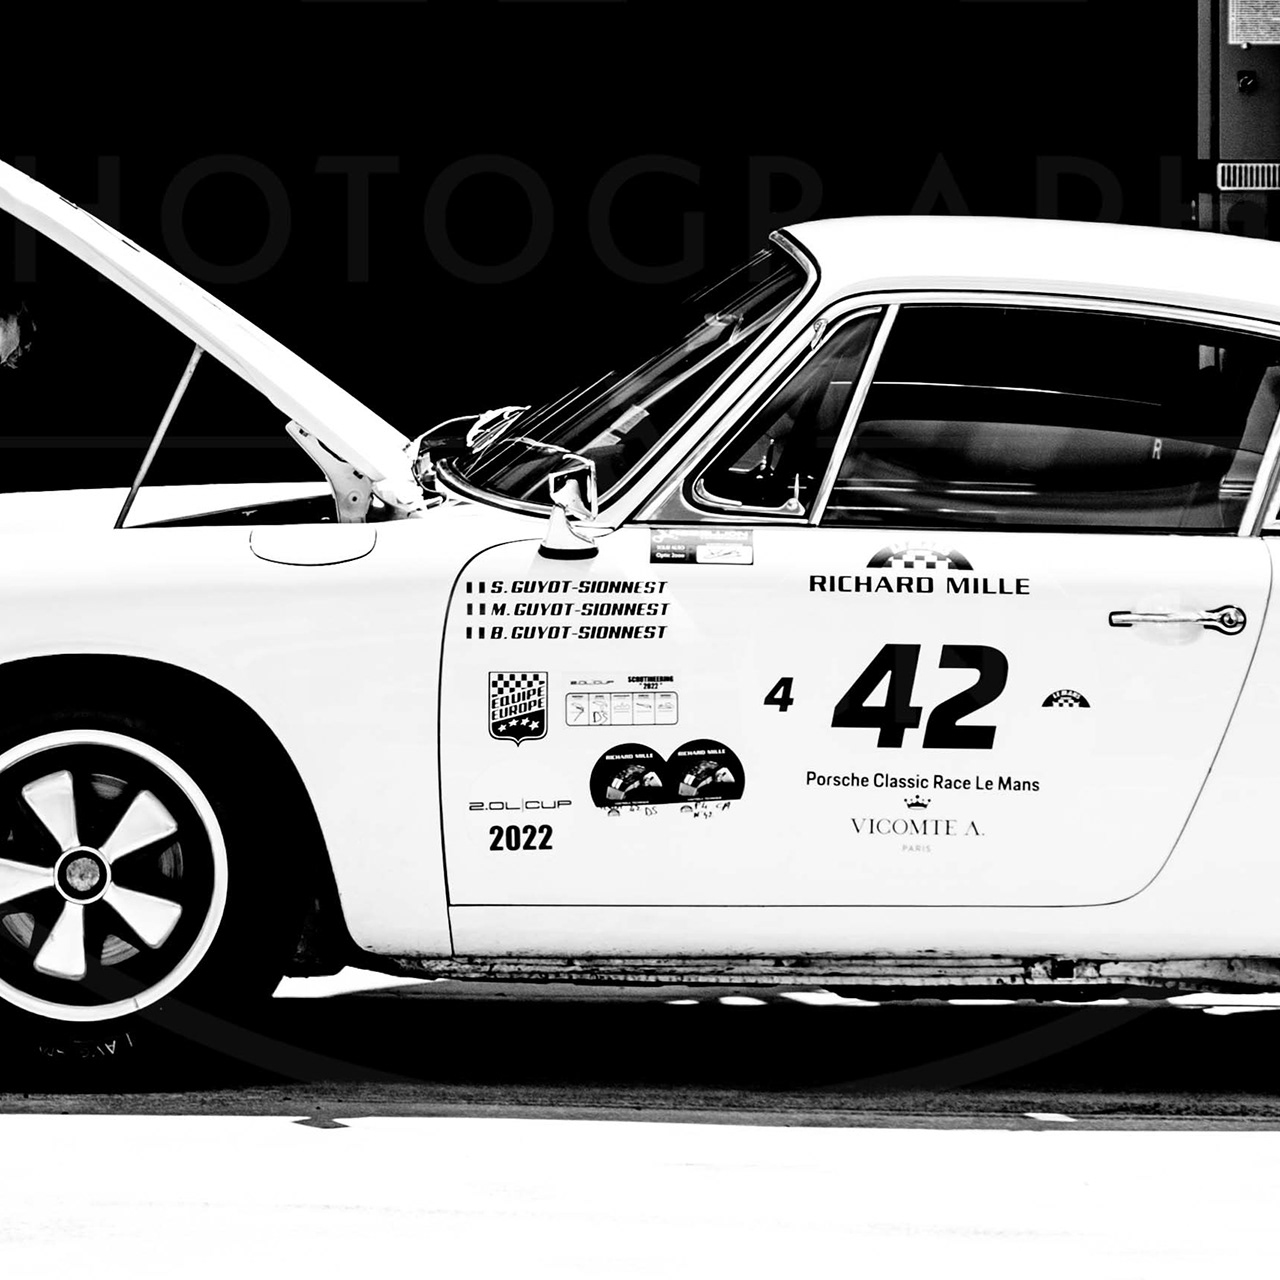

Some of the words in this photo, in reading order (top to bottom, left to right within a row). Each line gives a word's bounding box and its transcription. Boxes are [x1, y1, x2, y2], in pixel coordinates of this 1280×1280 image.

[809, 575, 934, 593] RICHARD
[946, 577, 1030, 595] MILLE
[491, 685, 546, 710] EQUIPE
[764, 677, 795, 712] 4
[831, 643, 1009, 750] 42
[491, 697, 546, 721] EUROPE
[806, 771, 870, 787] Porsche
[873, 773, 929, 789] Classic
[933, 775, 971, 790] Race
[975, 776, 994, 791] Le
[997, 776, 1040, 792] Mans
[488, 824, 553, 851] 2022
[850, 818, 958, 836] VICOMTE
[902, 844, 932, 854] PARIS
